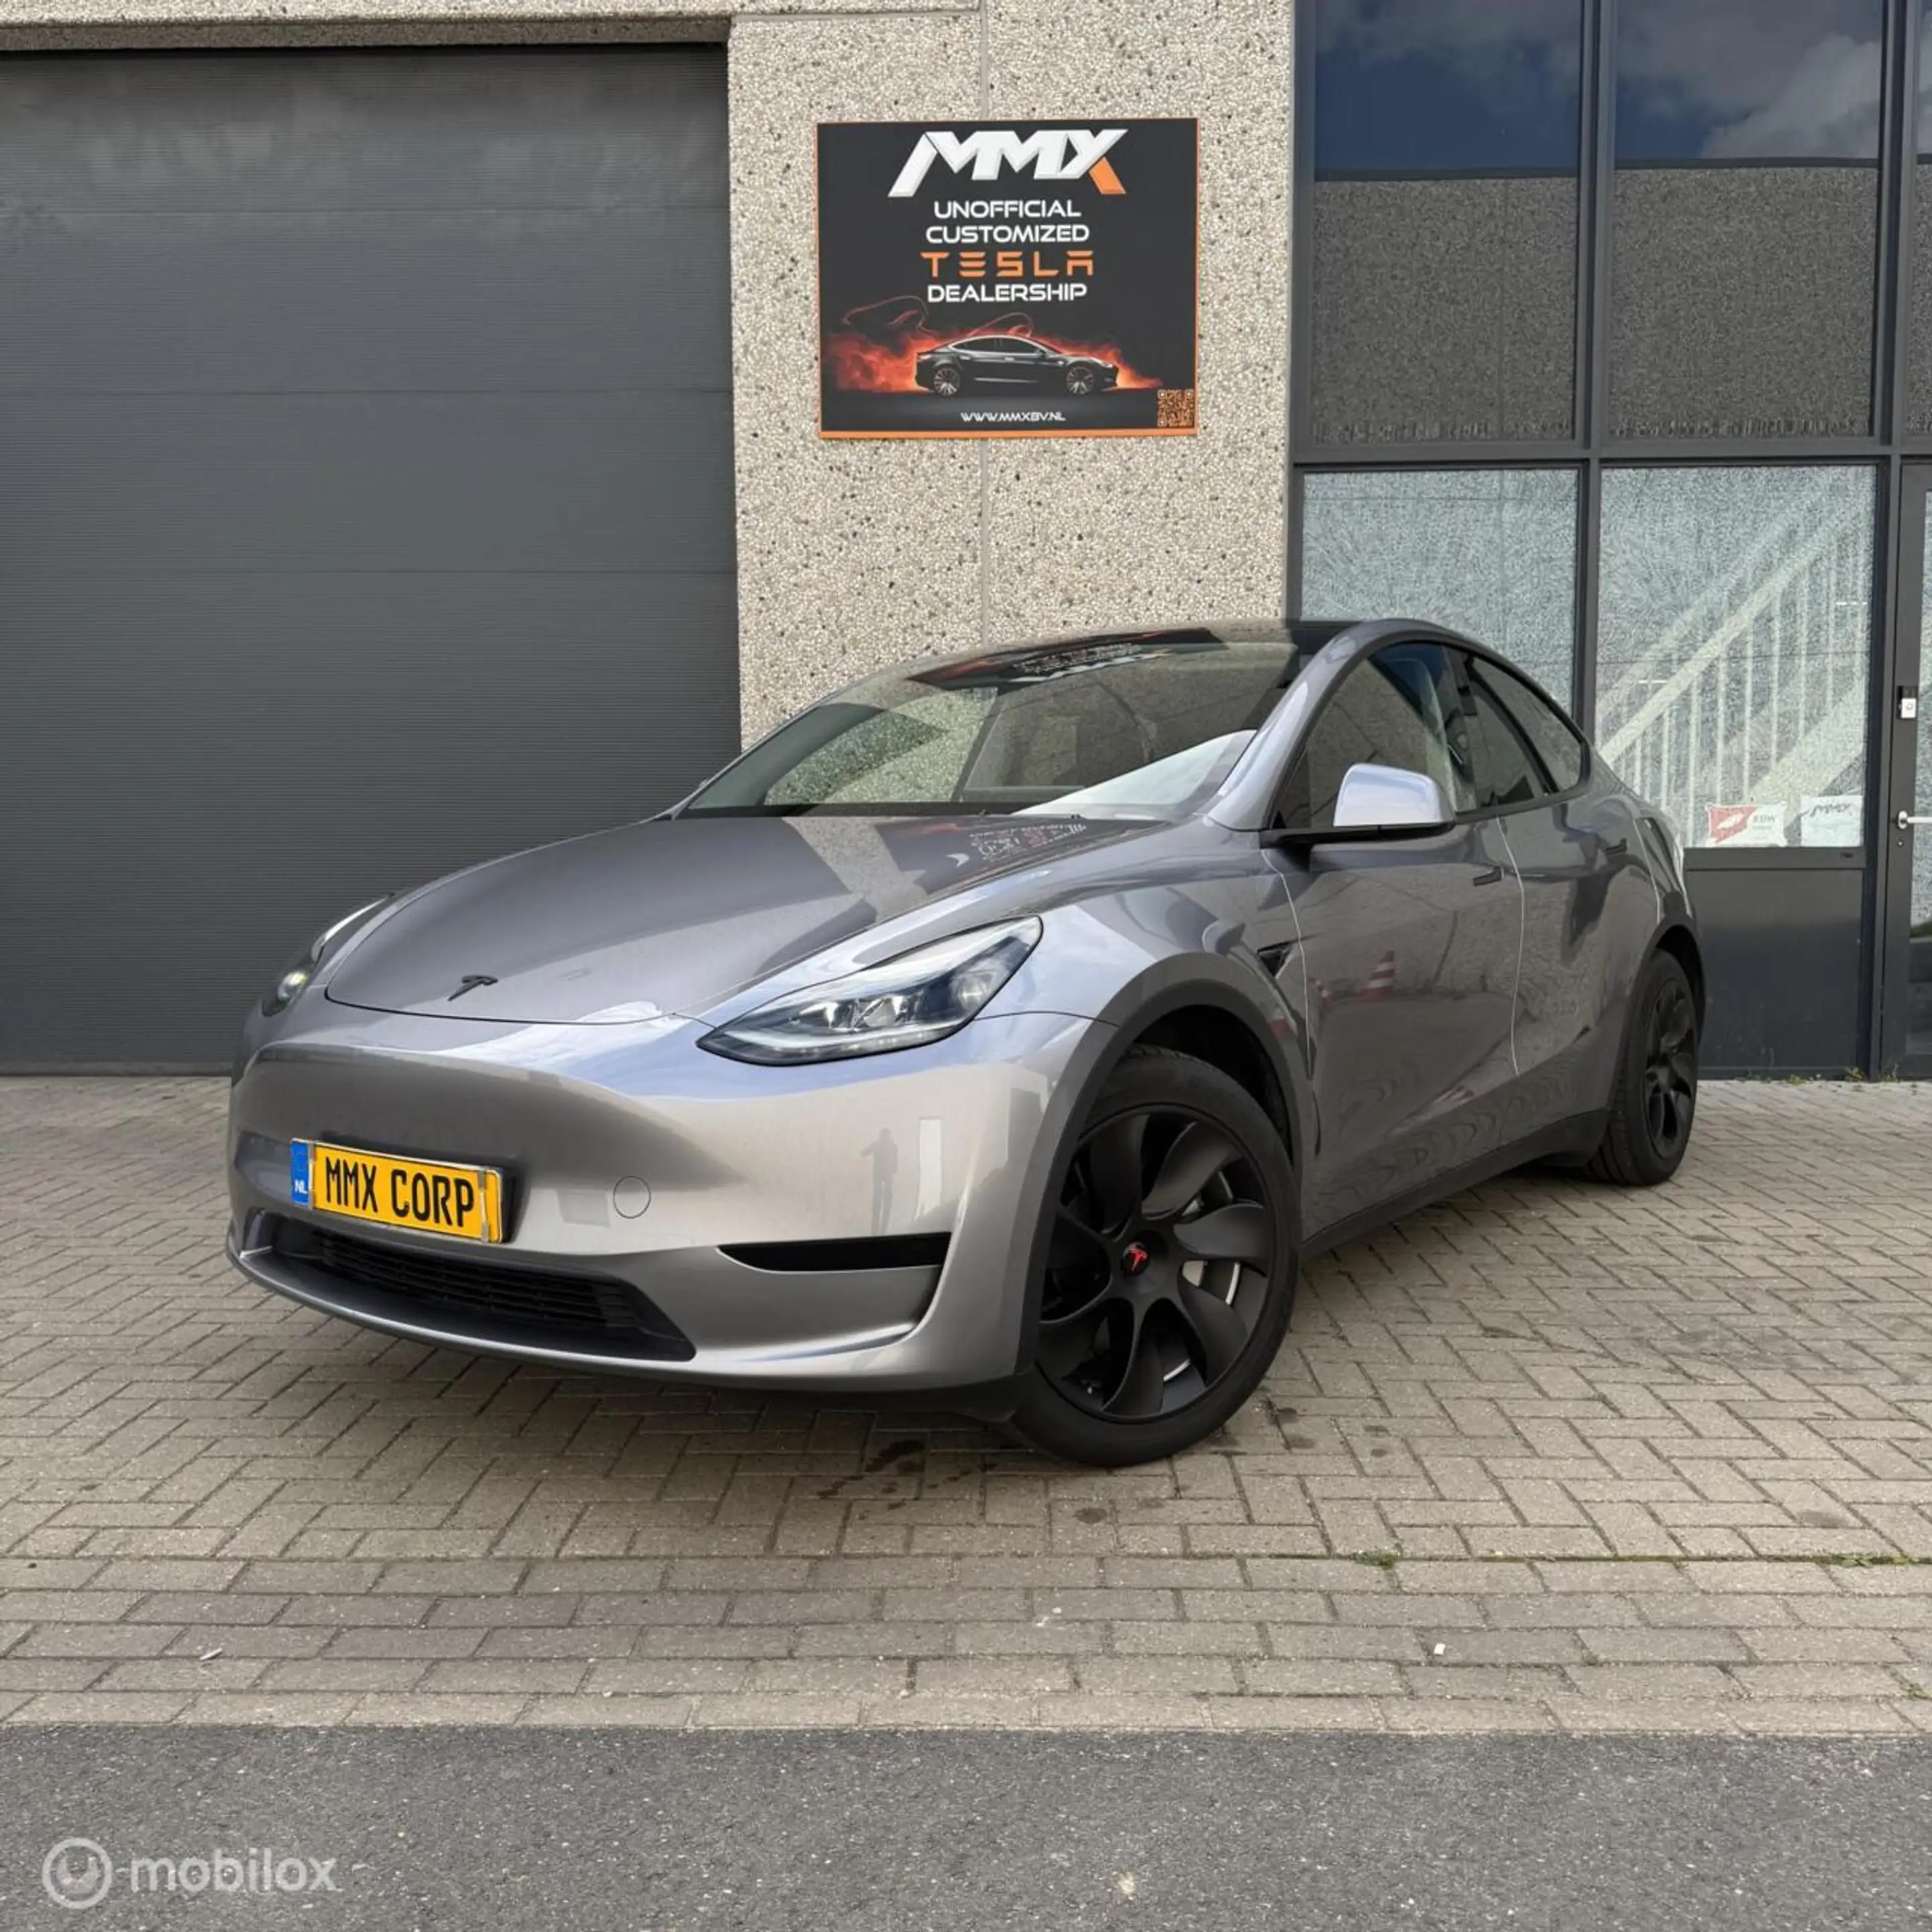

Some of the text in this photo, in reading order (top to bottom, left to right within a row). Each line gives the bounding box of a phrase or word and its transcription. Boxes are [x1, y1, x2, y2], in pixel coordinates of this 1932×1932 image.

[888, 129, 1128, 197] MMX
[933, 199, 1081, 219] UNOFFICIAL
[925, 224, 1089, 244] CUSTOMIZED
[920, 250, 1094, 278] TESLA
[927, 283, 1087, 303] DEALERSHIP
[960, 411, 1066, 423] WWW.MMXBV.NL
[294, 1179, 307, 1194] NL
[325, 1156, 475, 1228] MMX CORP
